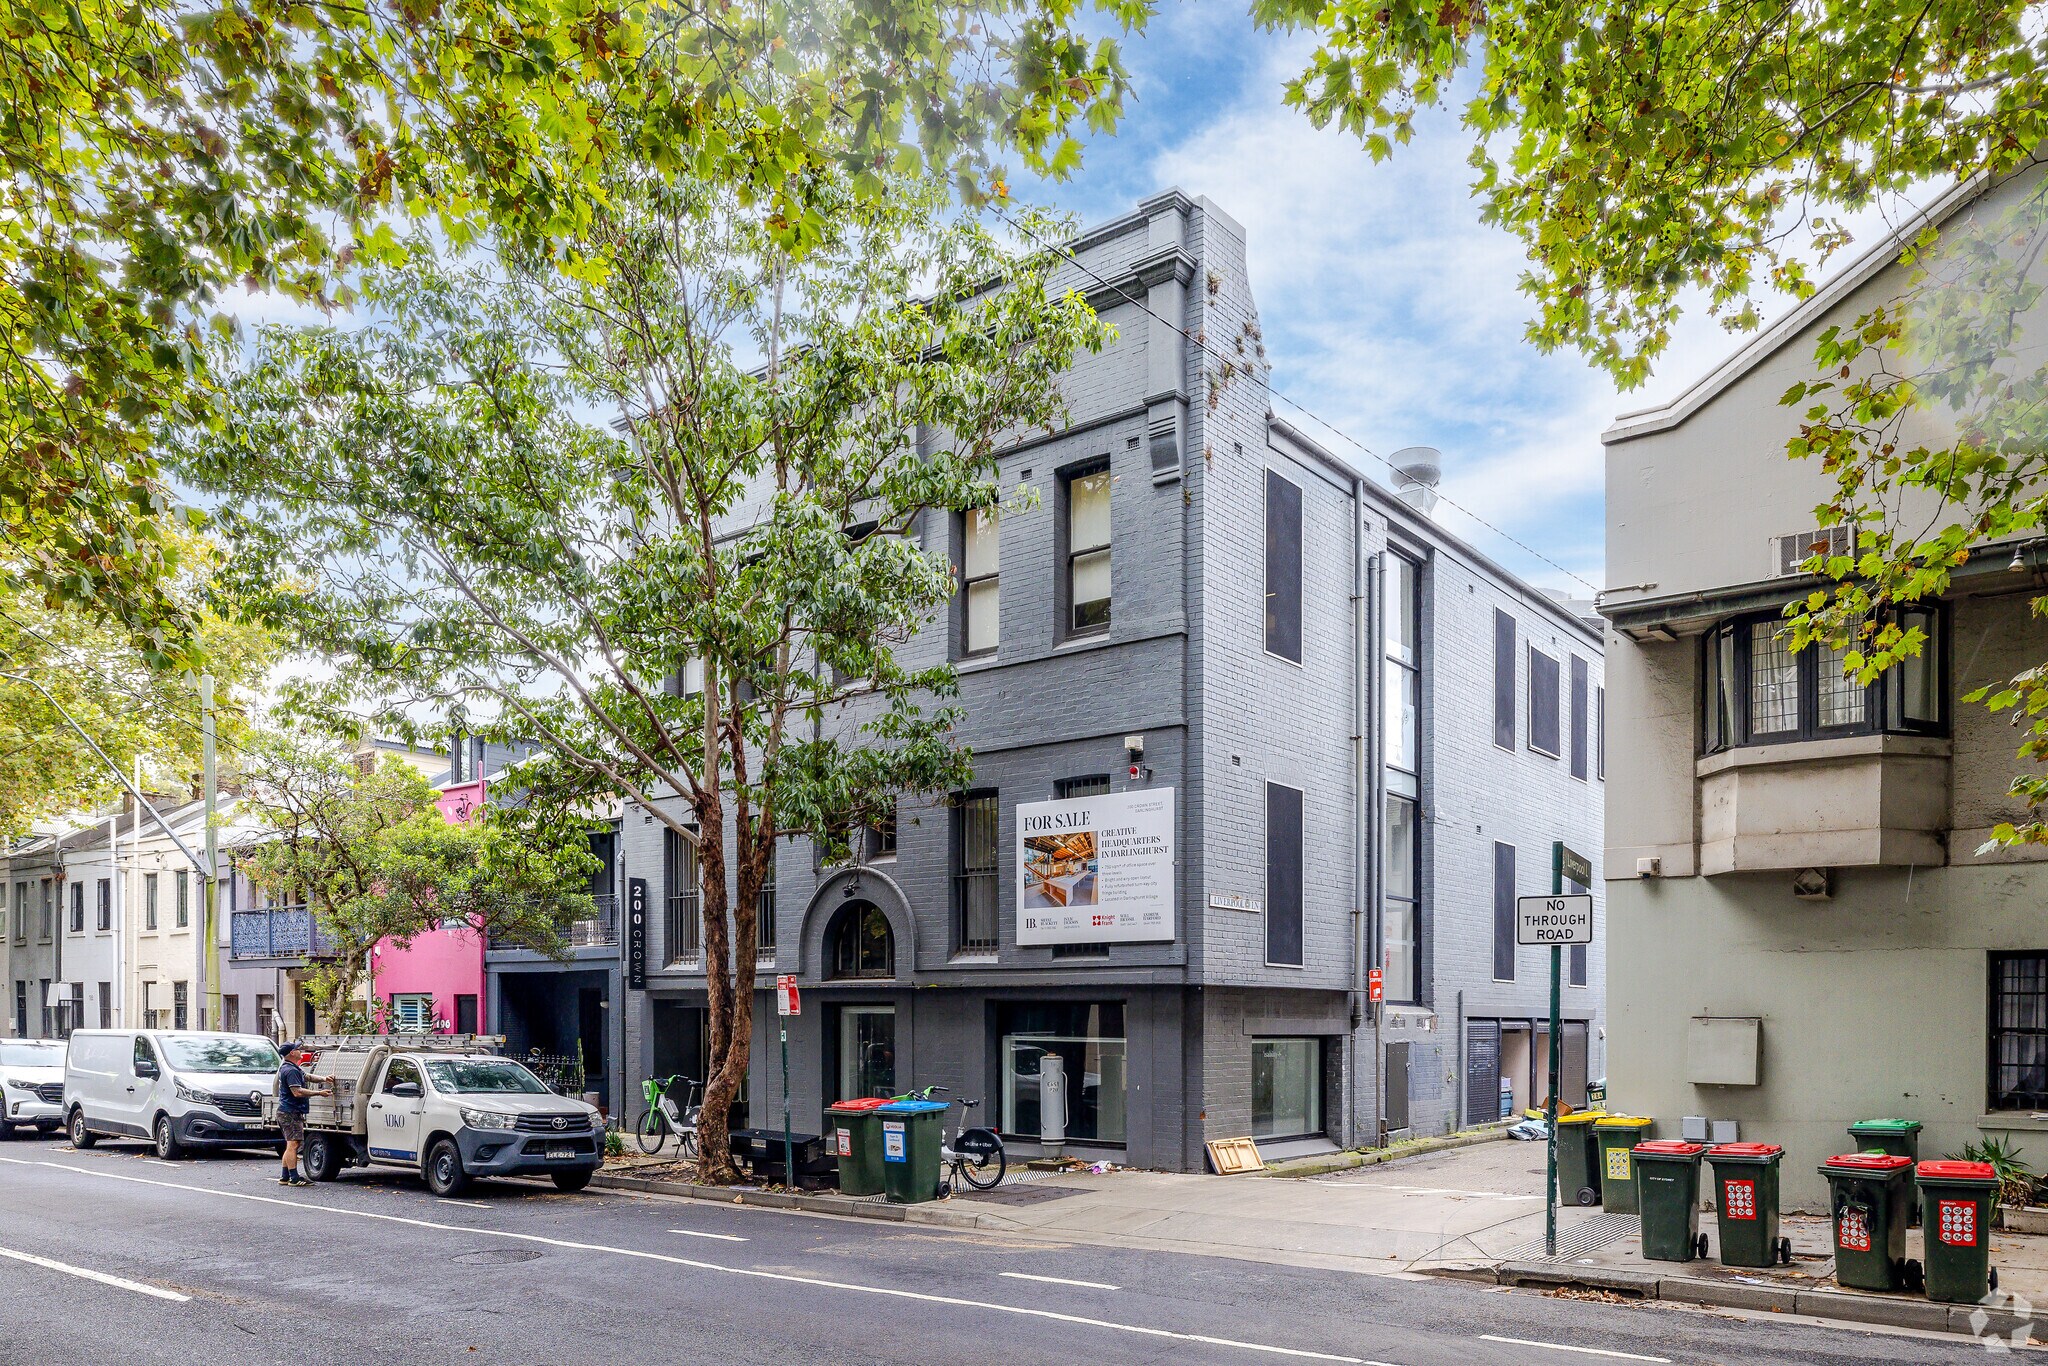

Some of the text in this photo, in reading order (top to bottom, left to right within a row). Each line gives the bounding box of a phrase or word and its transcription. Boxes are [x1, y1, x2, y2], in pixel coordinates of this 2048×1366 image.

[1024, 810, 1091, 831] FOR SALE
[1101, 826, 1137, 838] CREATIVE
[1101, 835, 1161, 848] HEADQUARTERS
[1101, 845, 1169, 859] IN DARLINGHURST
[1567, 853, 1586, 875] Liverpool
[1214, 896, 1245, 908] LIVERPOOL
[1546, 899, 1565, 911] NO
[1524, 914, 1586, 926] THROUGH
[633, 885, 642, 983] 200 CROWN
[1537, 929, 1574, 940] ROAD
[436, 1019, 451, 1029] 196
[384, 1114, 405, 1128] ADKO
